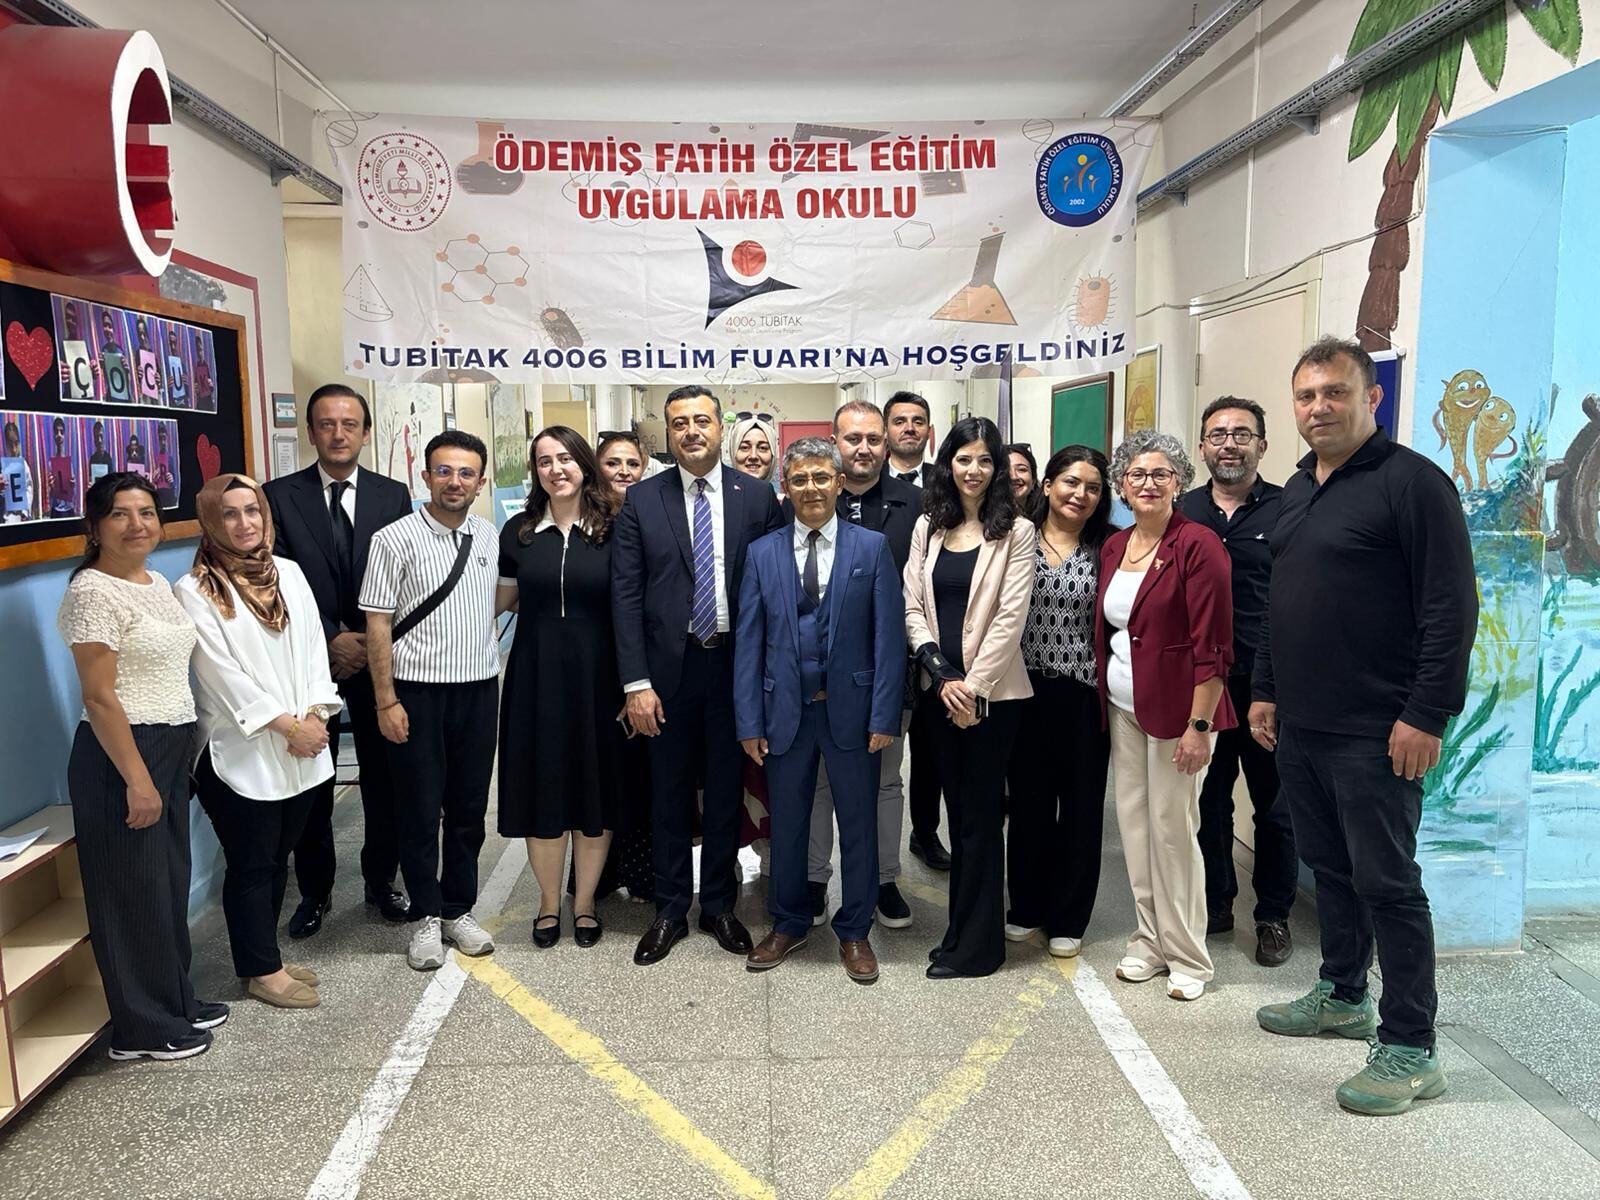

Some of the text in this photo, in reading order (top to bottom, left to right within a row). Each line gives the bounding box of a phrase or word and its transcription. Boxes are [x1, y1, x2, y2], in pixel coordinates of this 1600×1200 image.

[1049, 142, 1068, 157] ÖZEL
[1067, 135, 1099, 145] EĞİTİM
[495, 133, 997, 176] ÖDEMİŞ FATİH ÖZEL EĞİTİM
[1040, 158, 1052, 181] FATİH
[578, 186, 917, 220] UYGULAMA OKULU
[1039, 183, 1056, 215] ÖDEMİŞ
[1097, 187, 1117, 214] OKULU
[725, 316, 756, 327] 4006
[359, 340, 509, 368] TUBİTAK
[522, 348, 608, 368] 4006
[621, 342, 715, 369] BİLİM
[903, 331, 1125, 371] HOŞGELDİNİZ
[1333, 1013, 1365, 1025] LACOSTE
